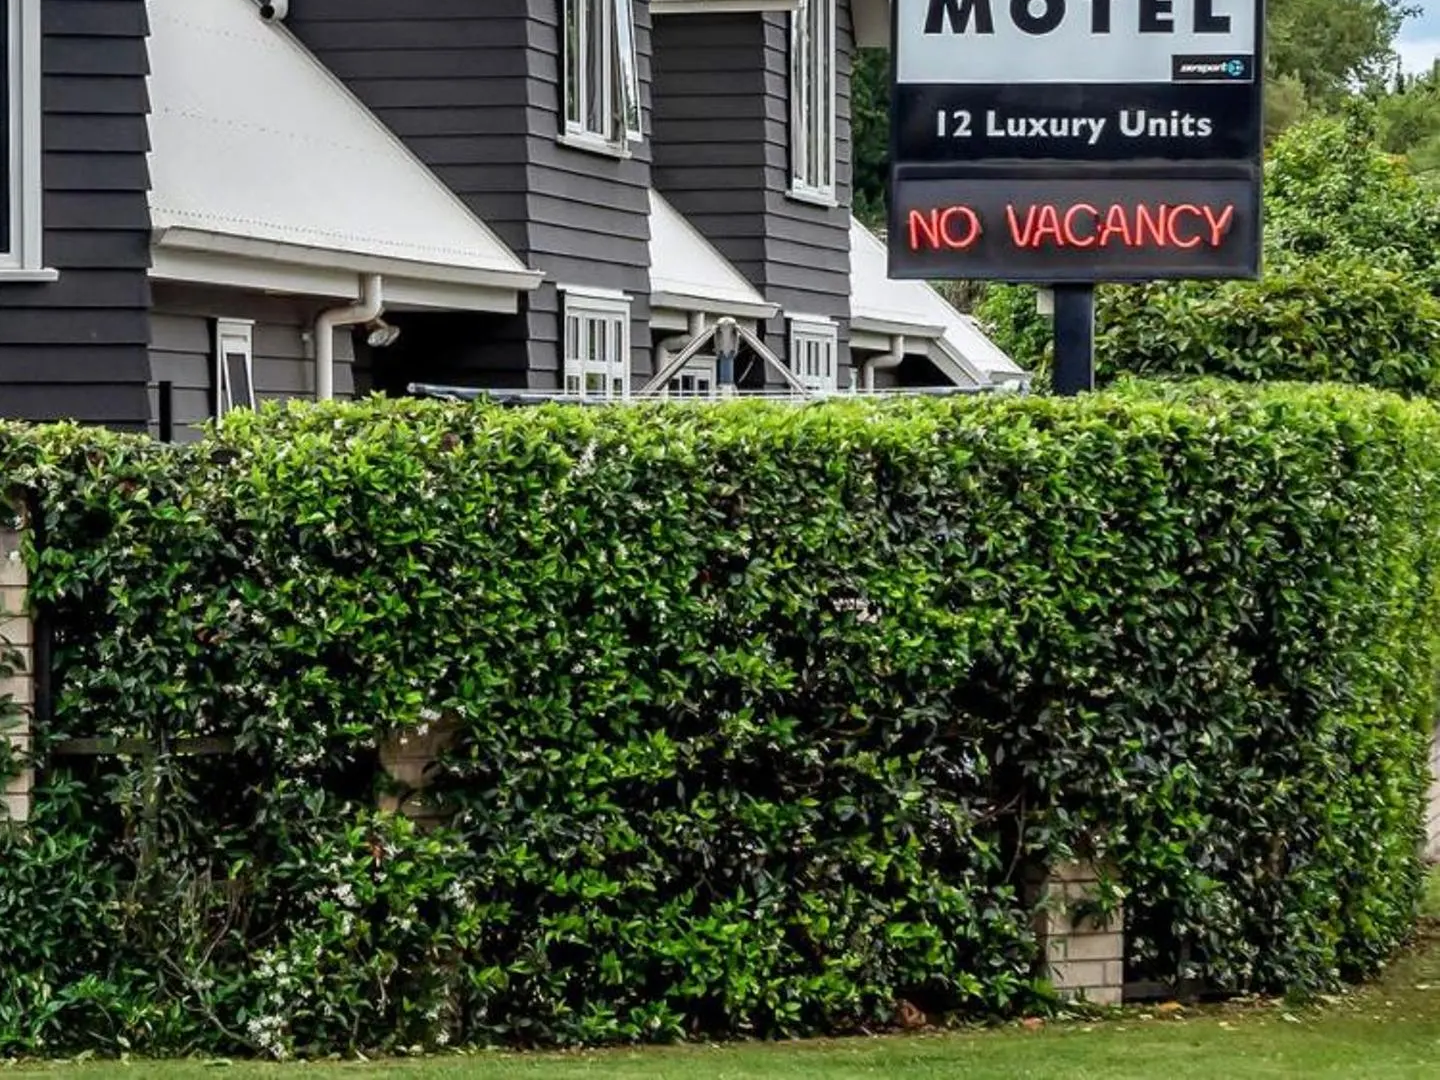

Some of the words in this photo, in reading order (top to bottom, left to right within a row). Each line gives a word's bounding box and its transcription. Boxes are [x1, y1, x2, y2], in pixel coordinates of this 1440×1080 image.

[937, 110, 973, 137] 12
[986, 110, 1107, 144] Luxury
[1119, 109, 1213, 138] Units
[907, 206, 981, 250] NO
[1006, 203, 1234, 249] VACANCY
